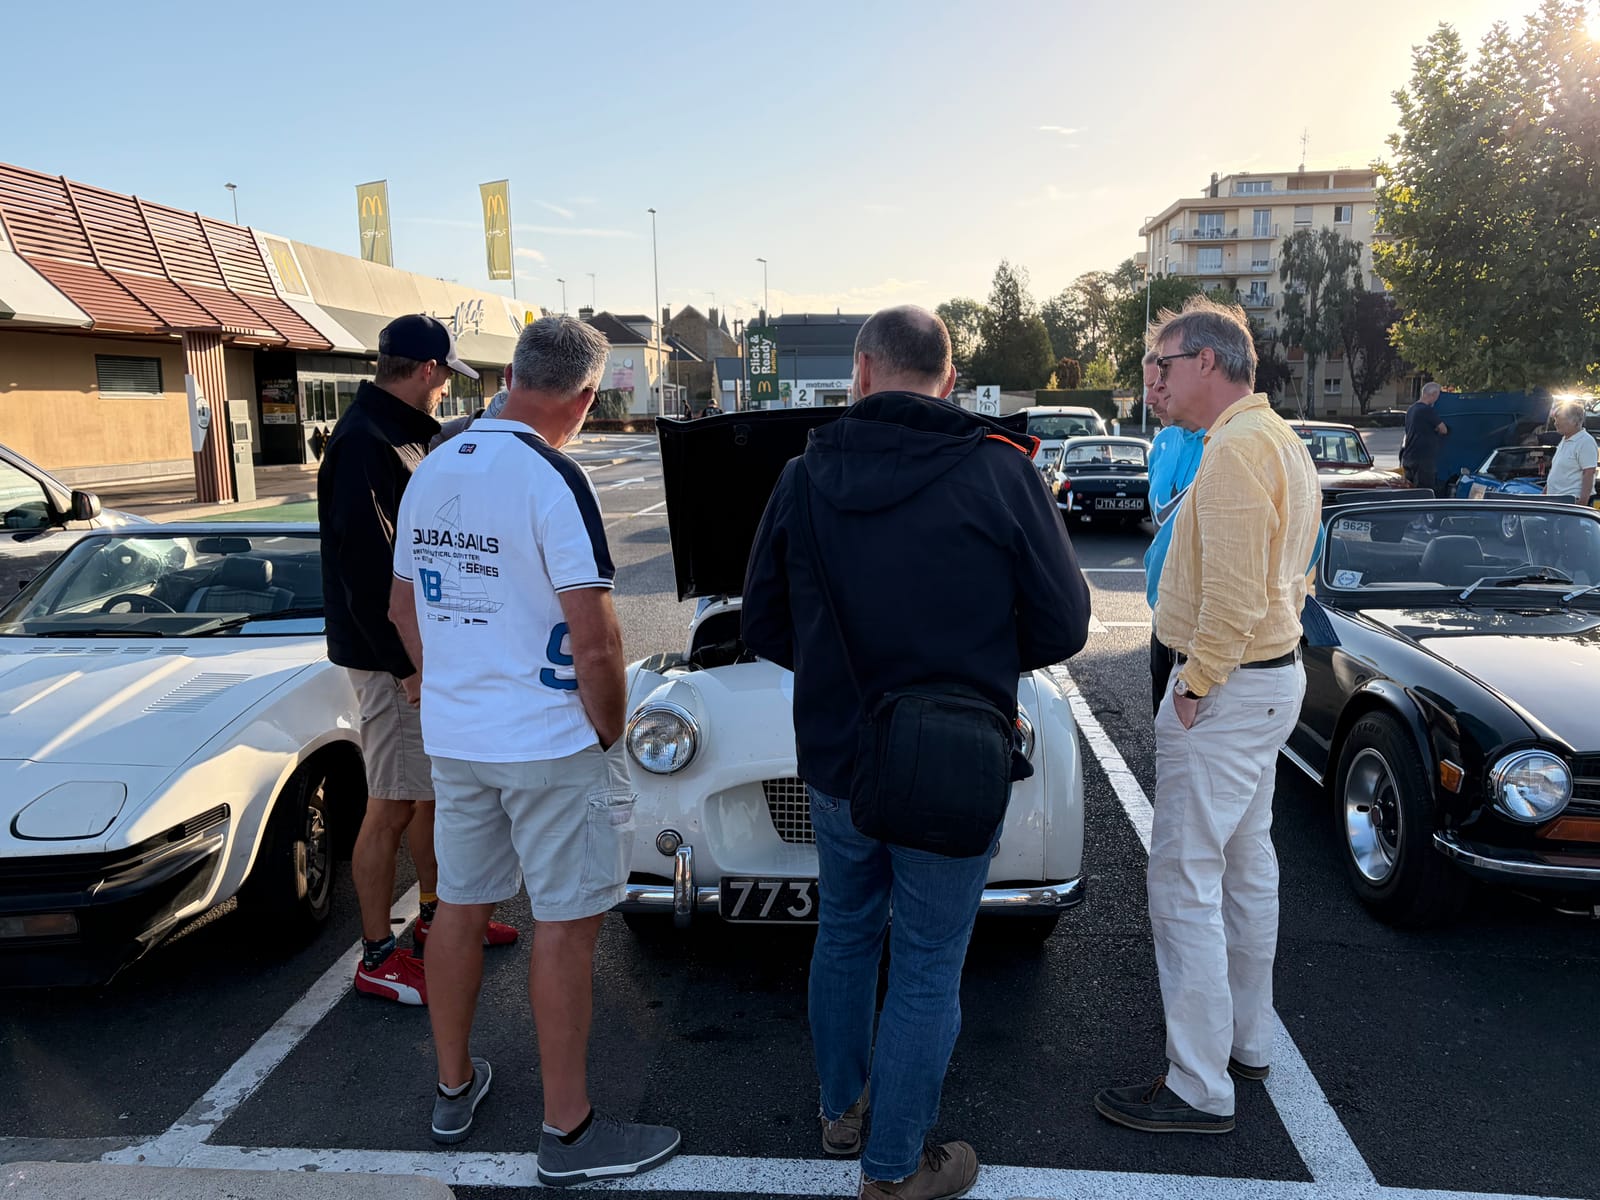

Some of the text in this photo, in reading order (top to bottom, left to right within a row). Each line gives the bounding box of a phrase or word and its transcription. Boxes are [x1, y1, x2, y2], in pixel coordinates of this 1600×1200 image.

[749, 346, 760, 375] Click
[761, 338, 772, 374] Ready
[798, 389, 807, 402] 2
[982, 387, 992, 400] 4
[1097, 499, 1116, 509] JTN
[729, 881, 813, 918] 773
